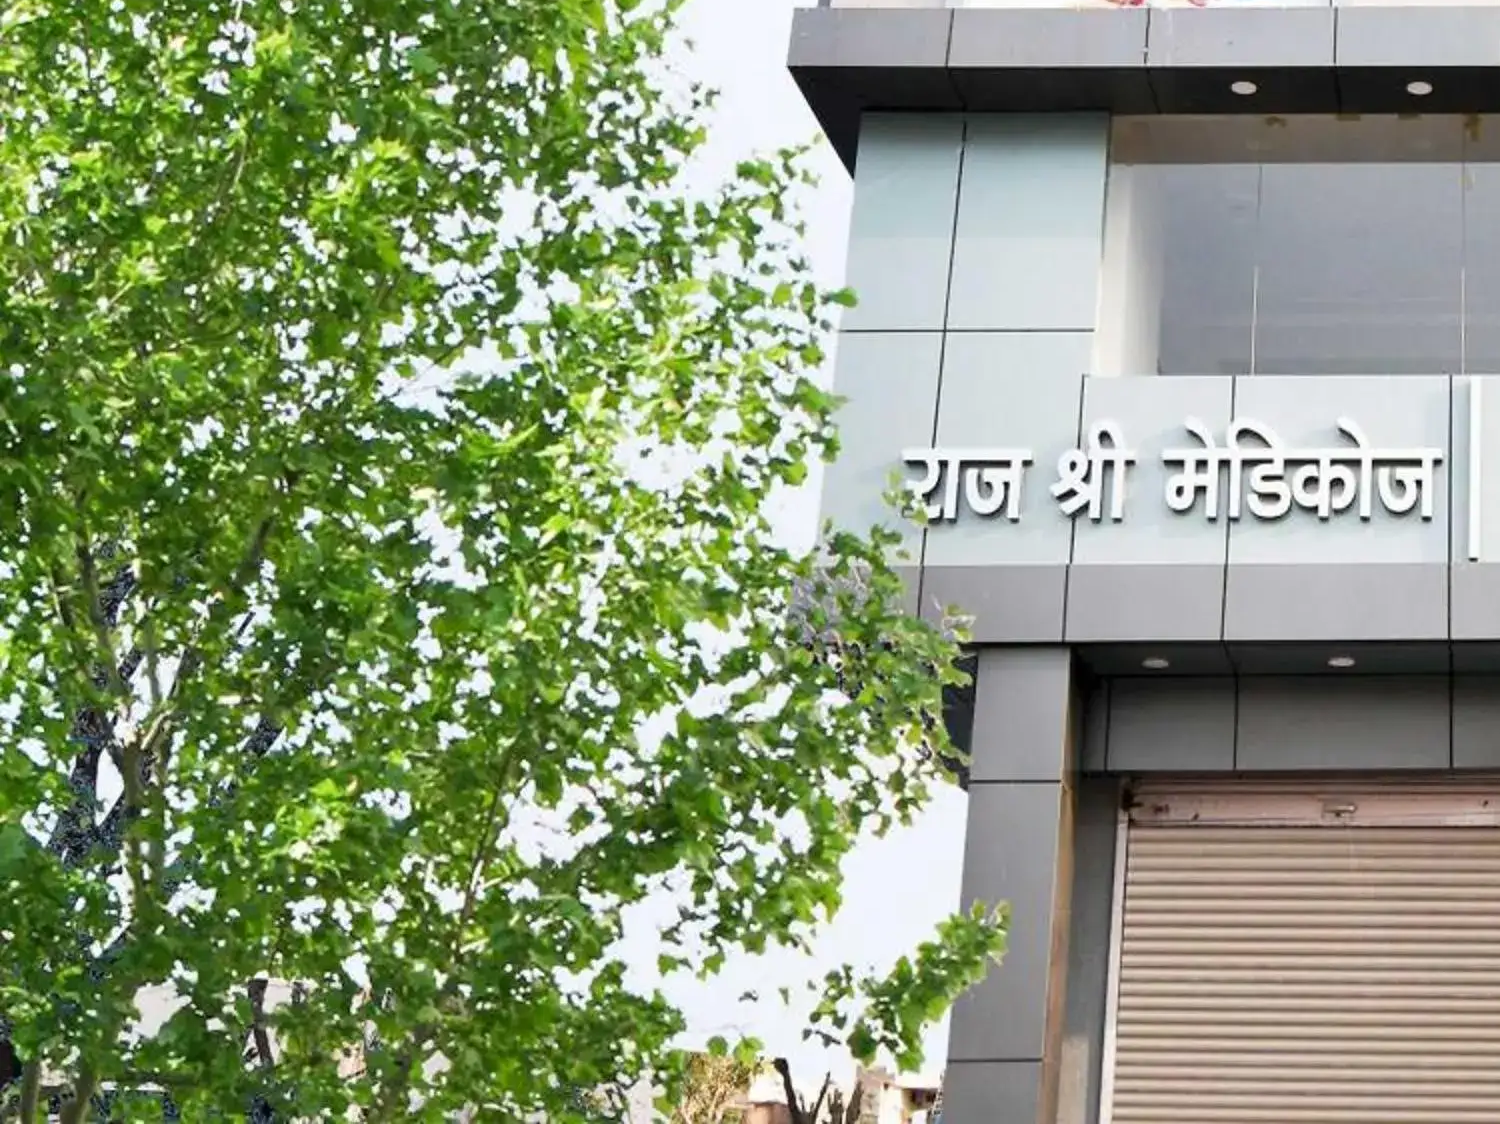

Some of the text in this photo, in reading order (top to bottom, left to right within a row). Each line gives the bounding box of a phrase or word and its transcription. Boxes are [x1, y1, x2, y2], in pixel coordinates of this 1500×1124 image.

[902, 415, 1443, 523] राज श्री मेडिकोज
